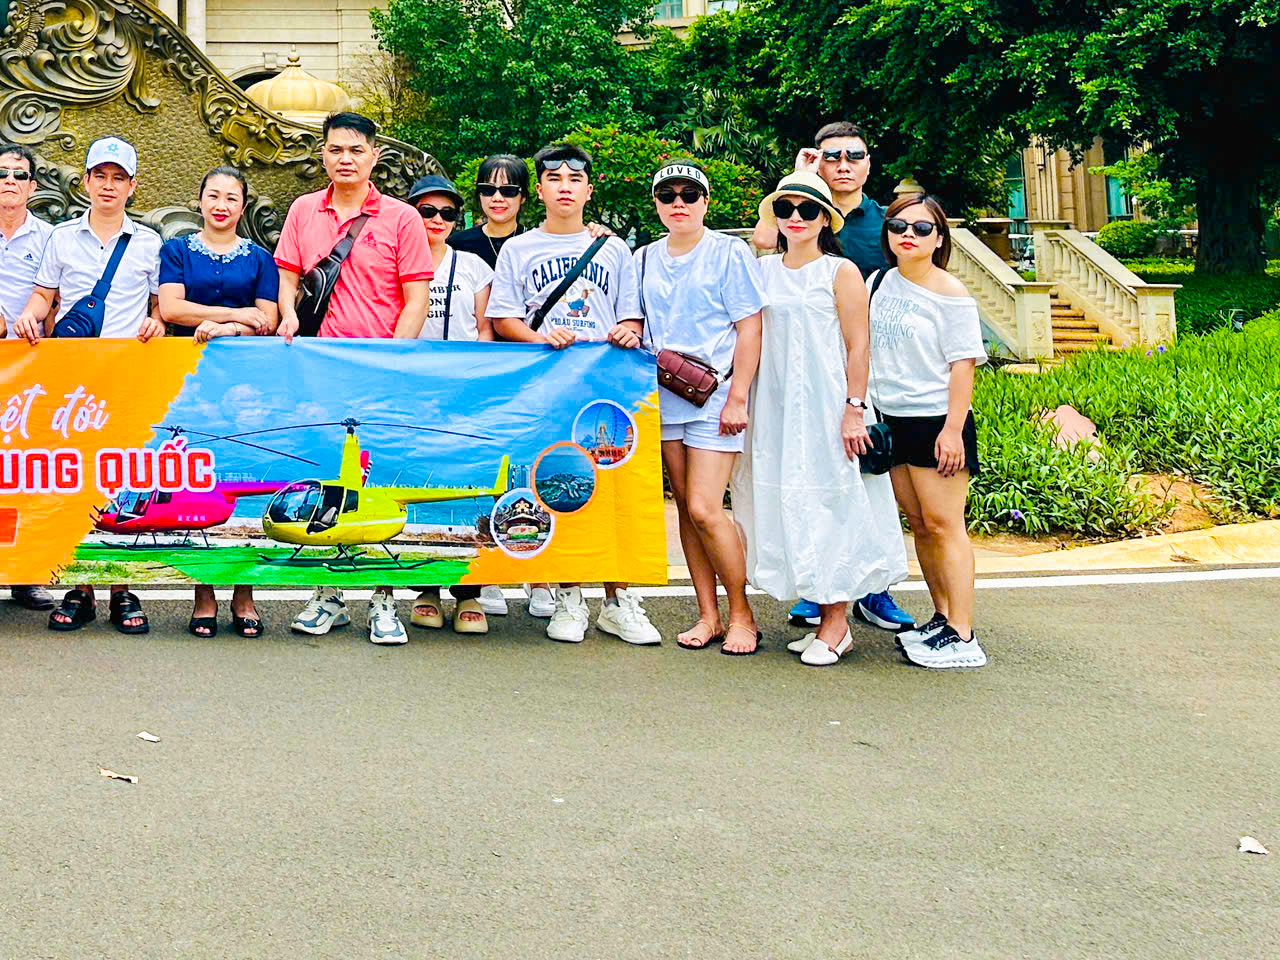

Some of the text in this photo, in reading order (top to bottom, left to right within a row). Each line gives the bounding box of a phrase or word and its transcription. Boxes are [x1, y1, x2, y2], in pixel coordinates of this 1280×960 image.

[660, 166, 701, 179] LOVED
[871, 319, 914, 339] REAMING
[52, 385, 110, 439] đới
[98, 438, 213, 495] QUỐC
